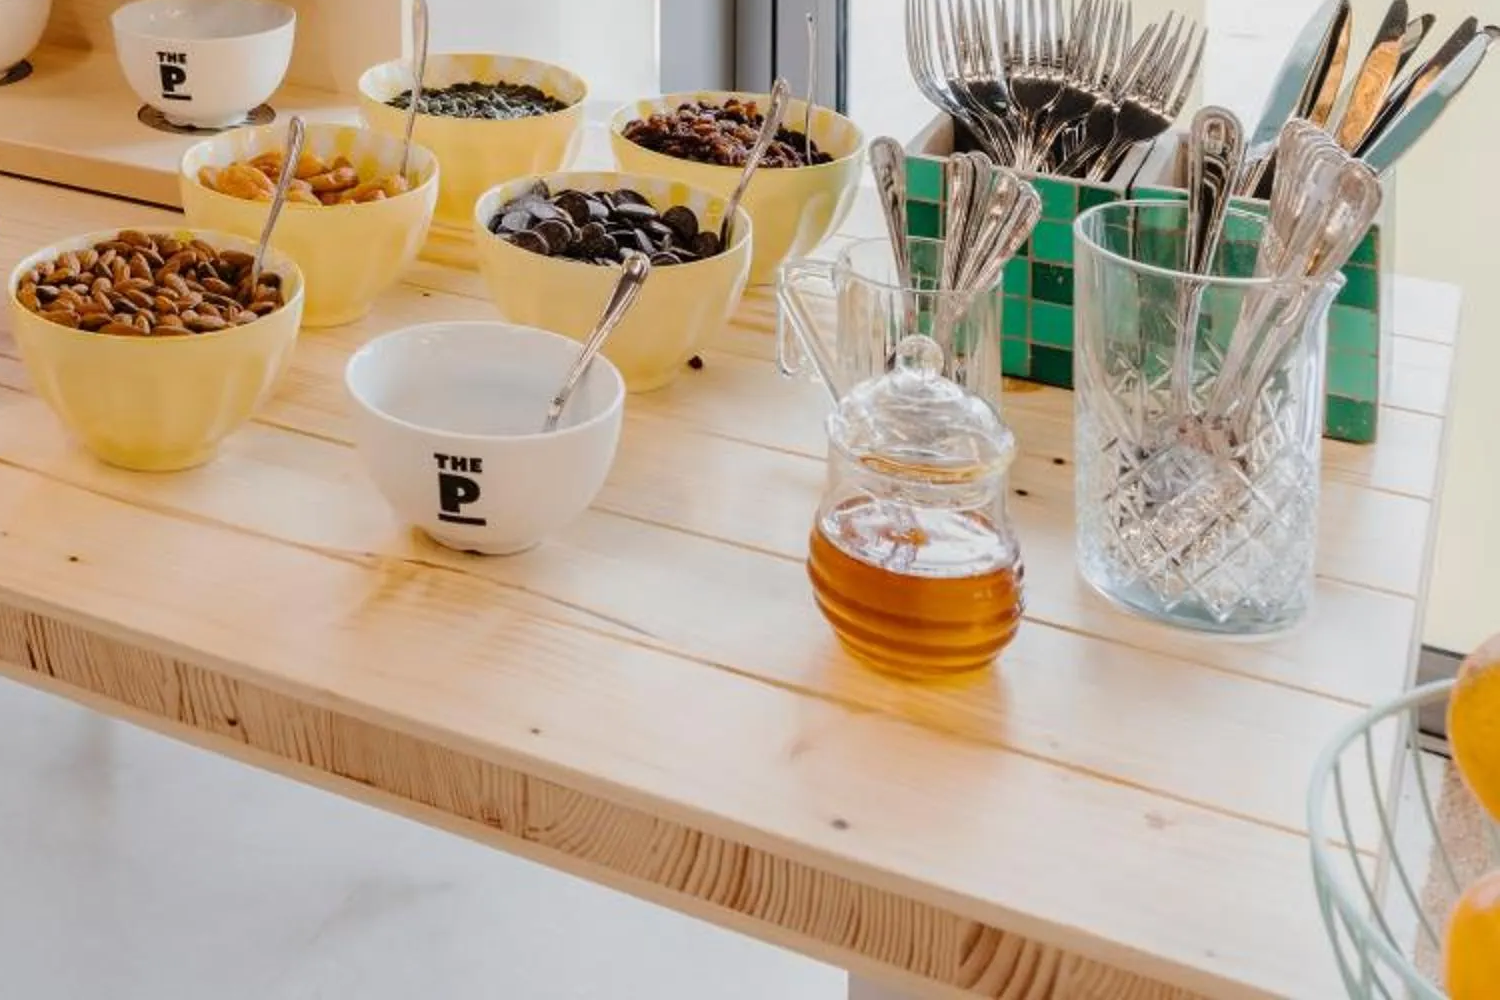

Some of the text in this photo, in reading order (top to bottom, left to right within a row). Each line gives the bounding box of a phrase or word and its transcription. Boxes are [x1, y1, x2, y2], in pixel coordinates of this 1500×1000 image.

[156, 51, 187, 64] THE
[160, 65, 187, 92] P
[433, 453, 483, 473] THE
[437, 472, 481, 513] P
